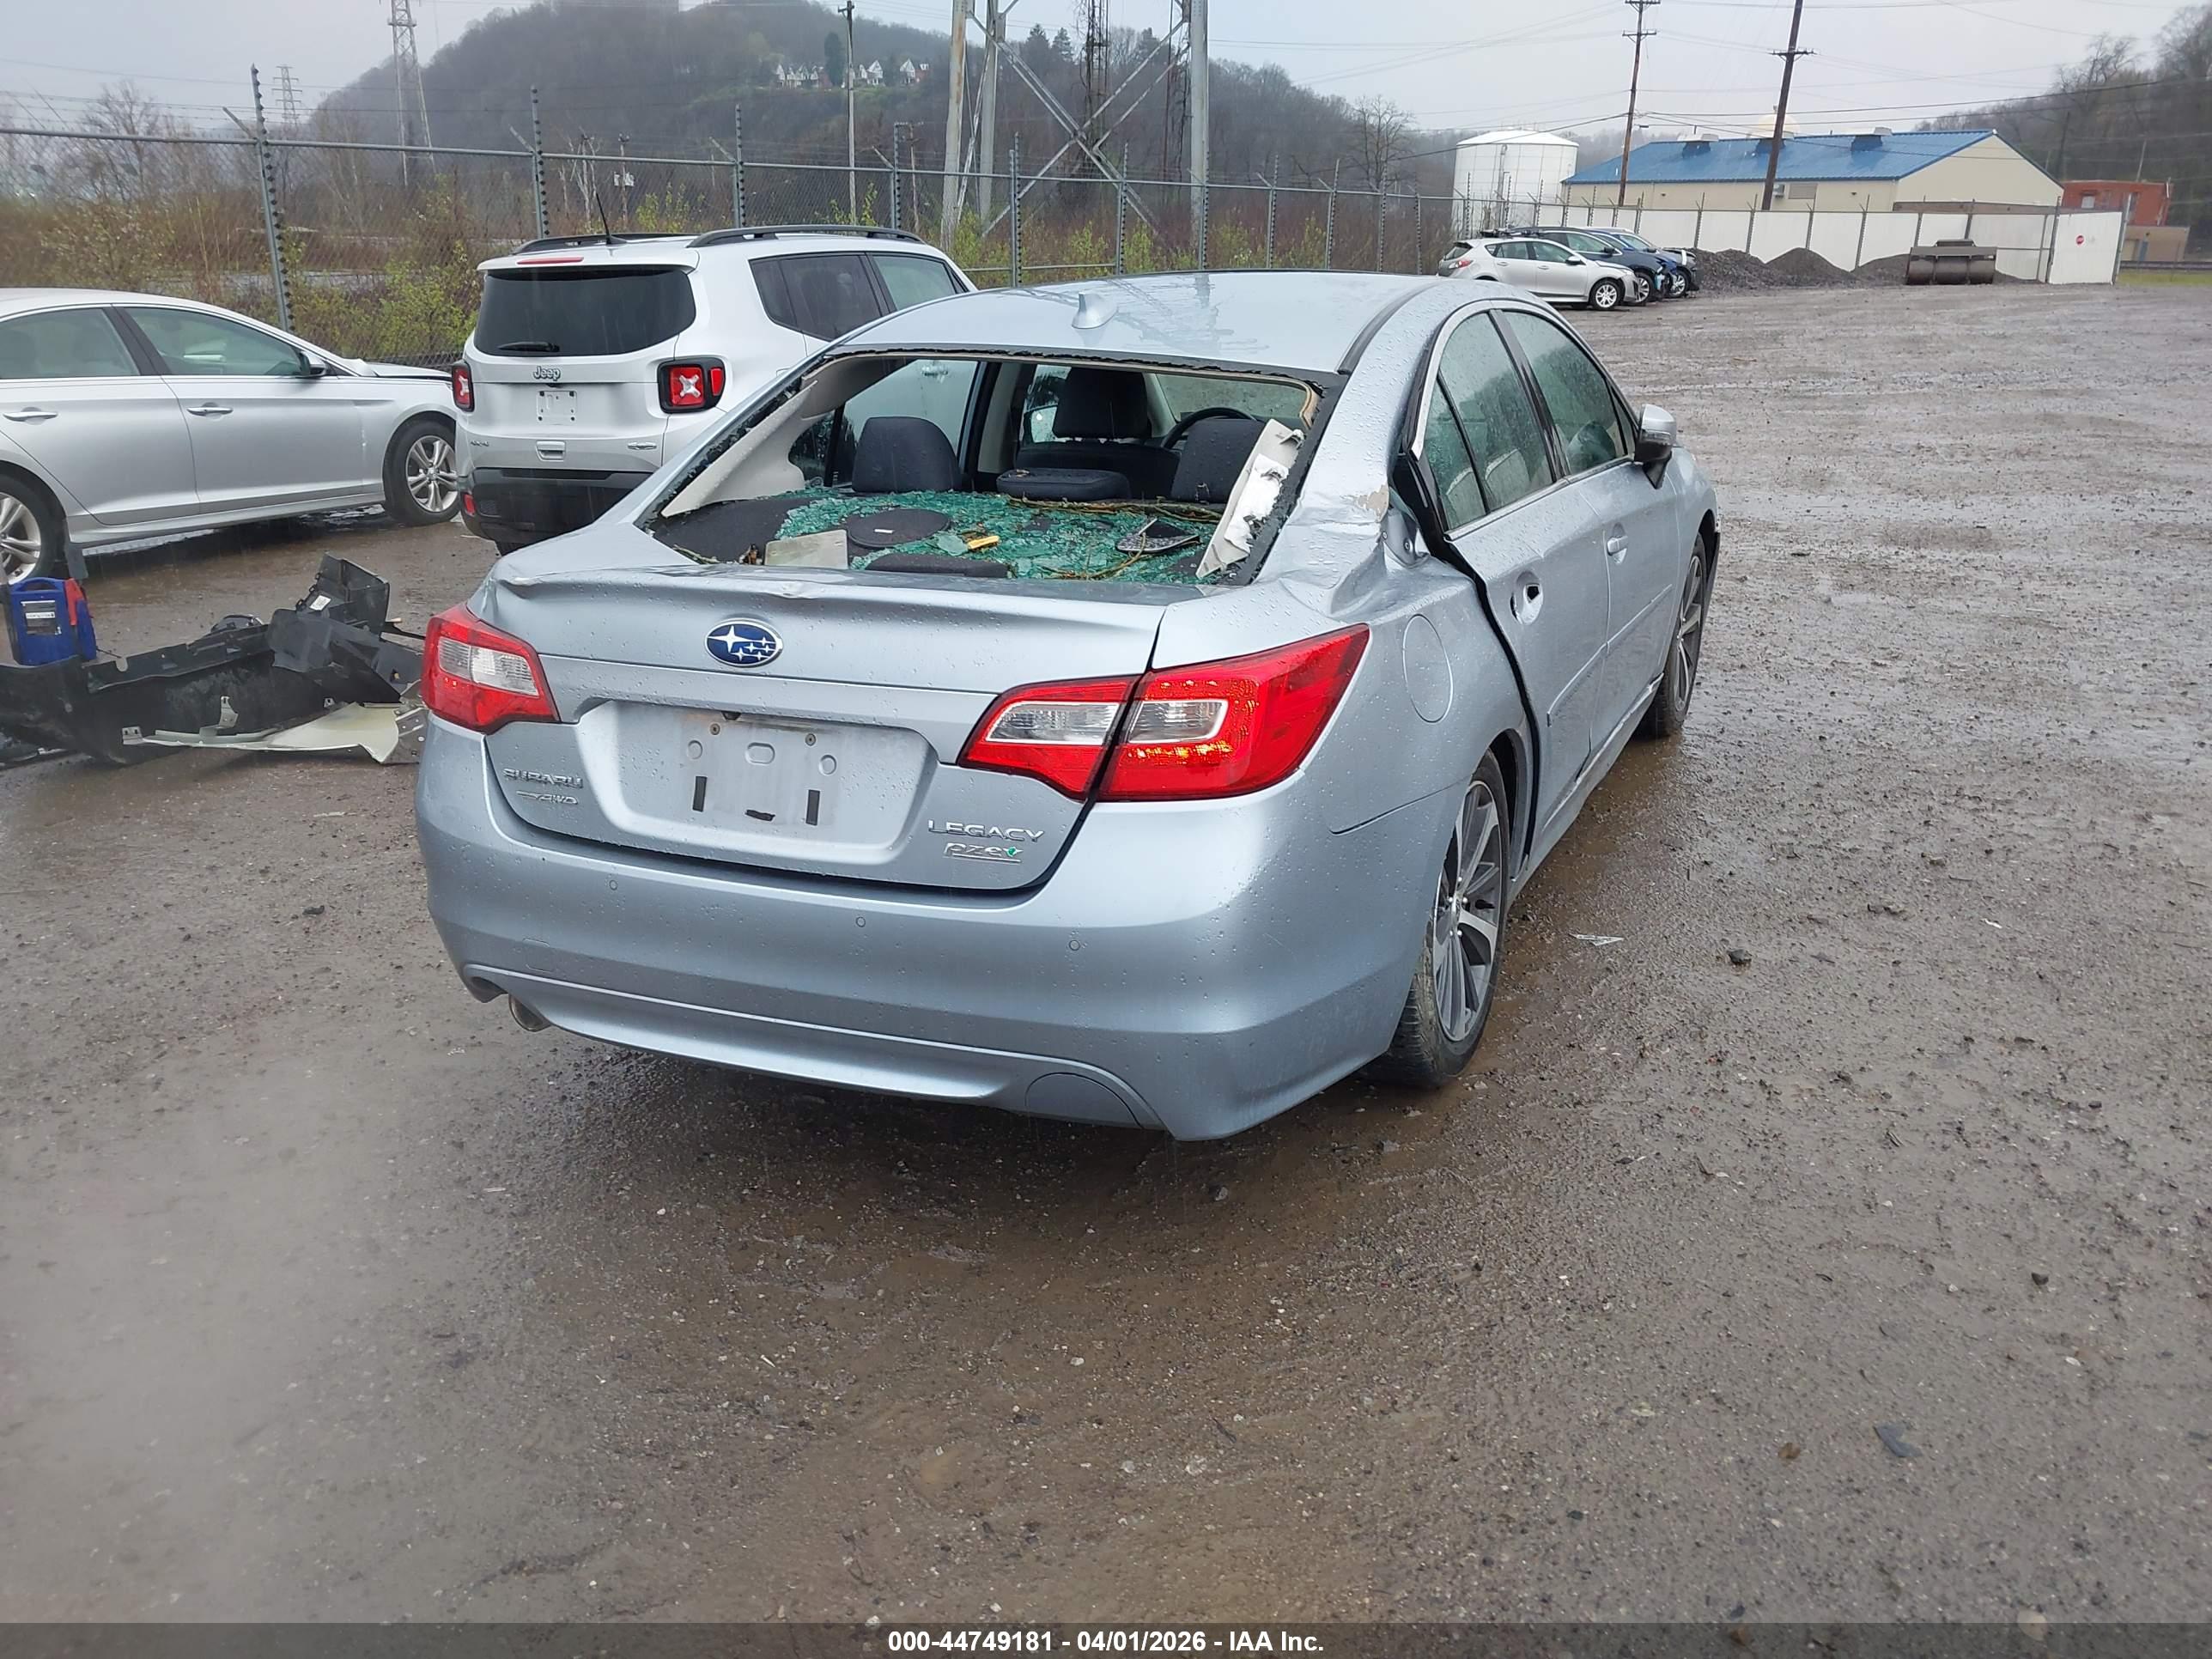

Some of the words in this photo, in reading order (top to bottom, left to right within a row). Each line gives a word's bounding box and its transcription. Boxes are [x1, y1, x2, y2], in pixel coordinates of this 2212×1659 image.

[533, 365, 562, 381] Jeep
[503, 768, 584, 789] SUBARU
[927, 819, 1045, 842] LEGACY
